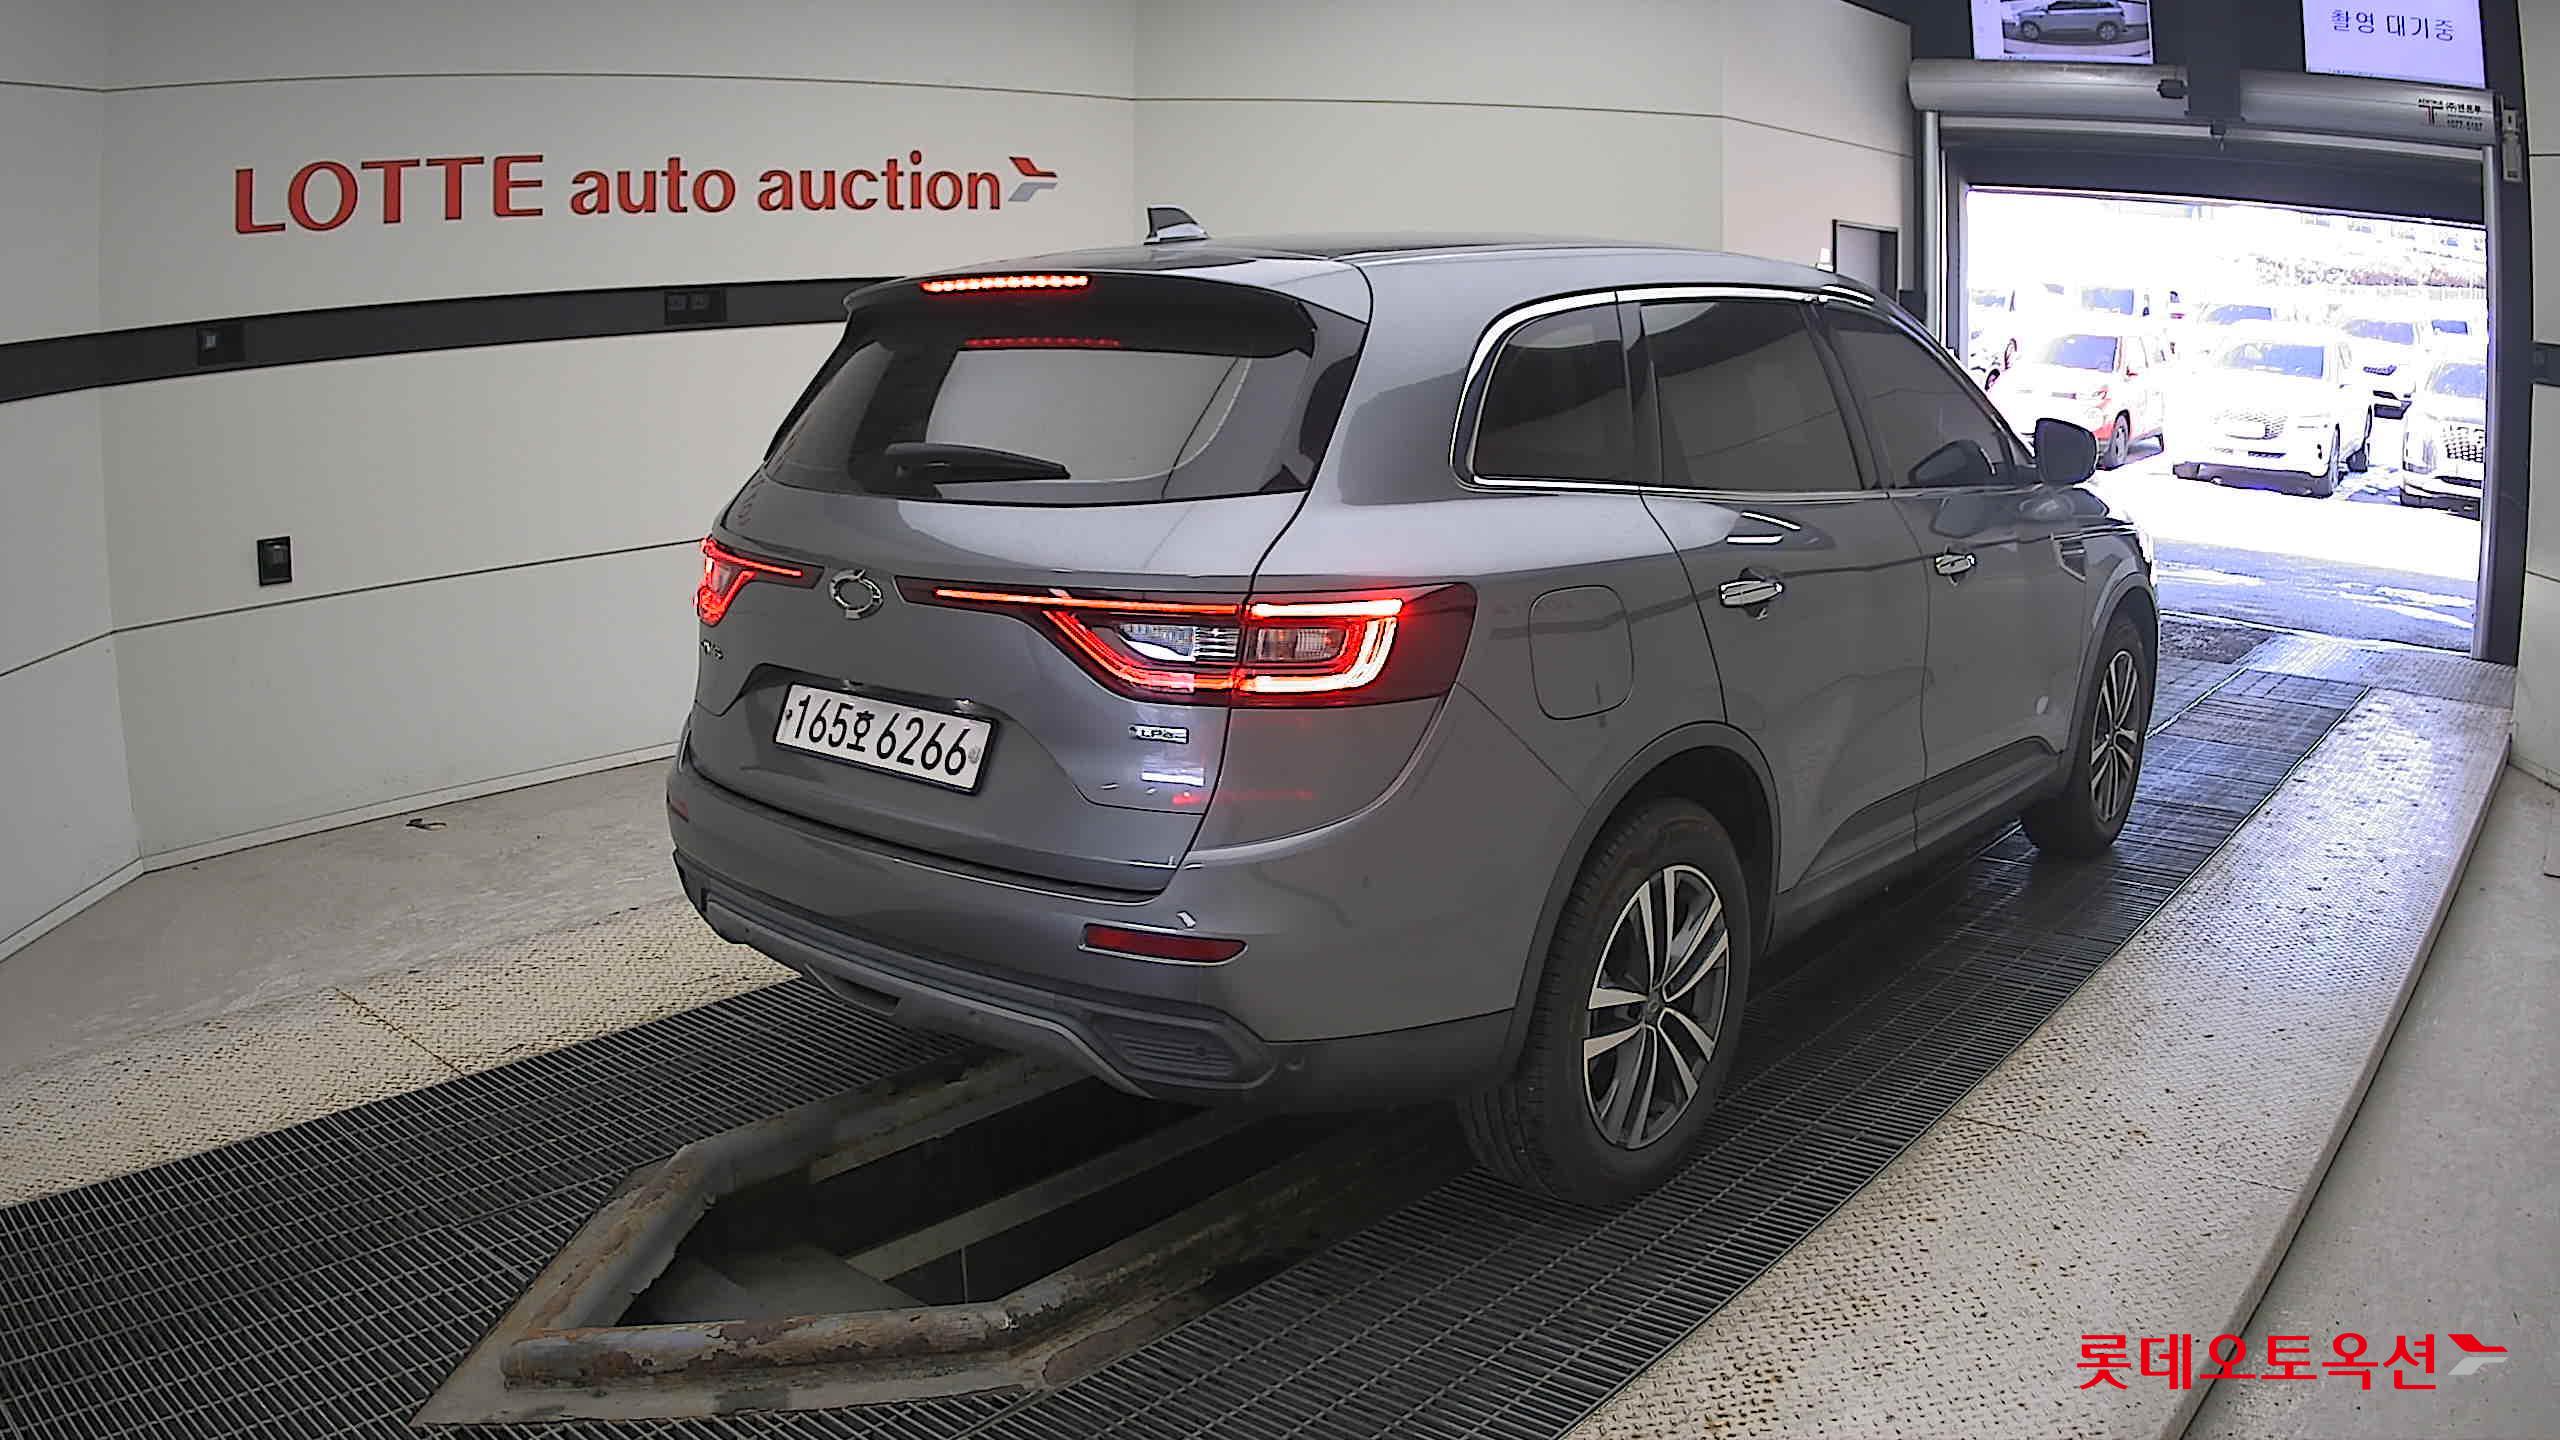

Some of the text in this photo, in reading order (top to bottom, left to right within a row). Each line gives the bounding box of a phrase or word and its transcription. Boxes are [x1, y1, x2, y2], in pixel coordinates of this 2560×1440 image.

[2332, 9, 2454, 42] 촬영 대기중
[234, 150, 1001, 233] LOTTE auto auction
